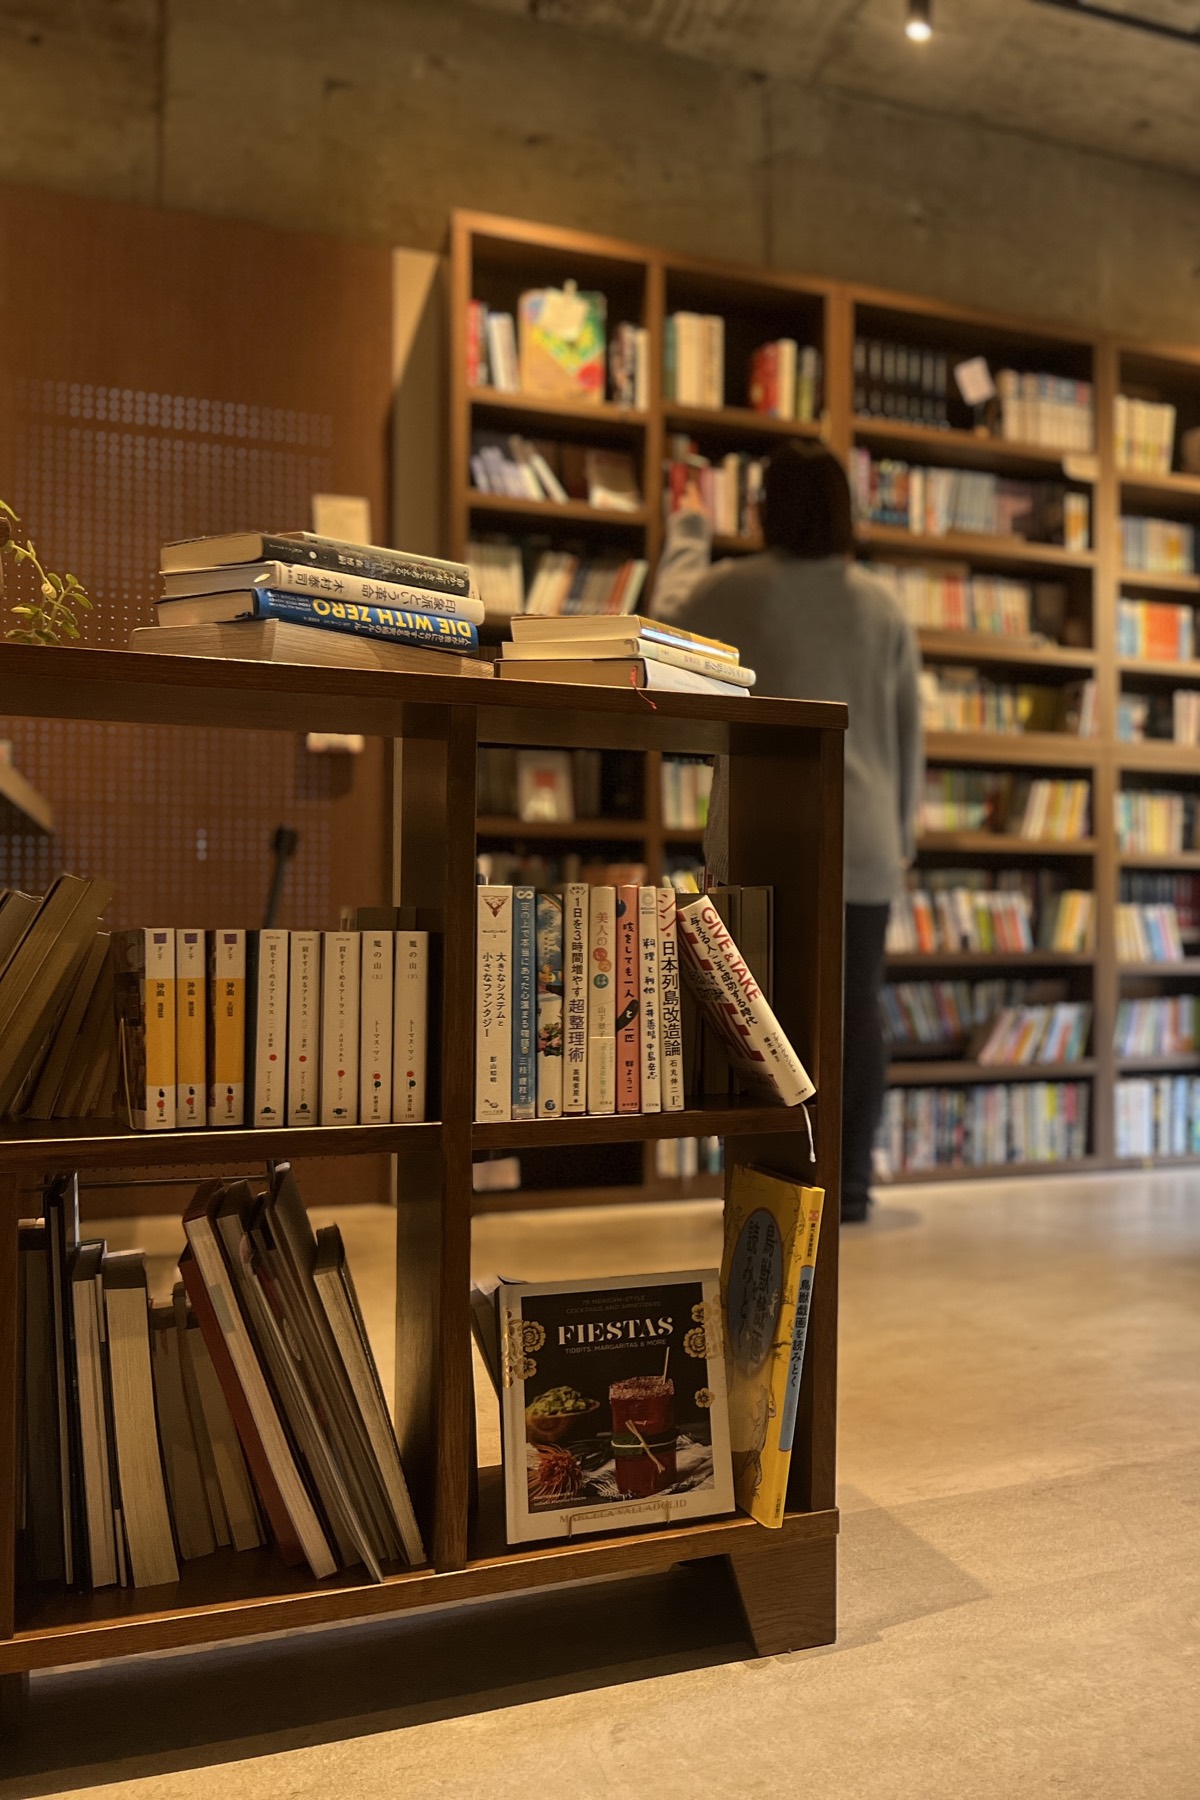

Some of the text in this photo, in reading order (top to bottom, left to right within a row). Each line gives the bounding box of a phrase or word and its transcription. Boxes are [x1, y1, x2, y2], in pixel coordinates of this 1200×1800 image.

[296, 572, 344, 594] 木村泰司
[361, 583, 457, 614] 印象派という革命
[312, 598, 372, 623] ZERO
[377, 608, 434, 632] WITH
[439, 617, 472, 638] DIE
[642, 938, 656, 995] 料理と利他
[657, 893, 681, 1057] シン・日本列島改造論
[701, 906, 734, 952] GIVE
[724, 952, 734, 963] &
[730, 955, 762, 1003] TAKE
[268, 944, 277, 1015] 肩をすくめるアトラス
[301, 945, 309, 1016] 肩をすくめるアトラス
[338, 945, 347, 1015] 肩をすくめるアトラス
[481, 952, 494, 1038] 小さなファンタジー
[494, 952, 507, 1027] 大きなシステムと
[622, 921, 636, 1043] 咳をしても一人と一匹
[407, 1019, 415, 1061] トーマス・マン
[624, 1060, 635, 1093] 群ようこ
[670, 1059, 680, 1094] 石丸伸二
[558, 1316, 674, 1346] FIESTAS
[594, 1341, 638, 1352] MARGARITAS
[646, 1338, 667, 1346] MORE
[790, 1279, 811, 1387] 鳥獣戯画を読みとく
